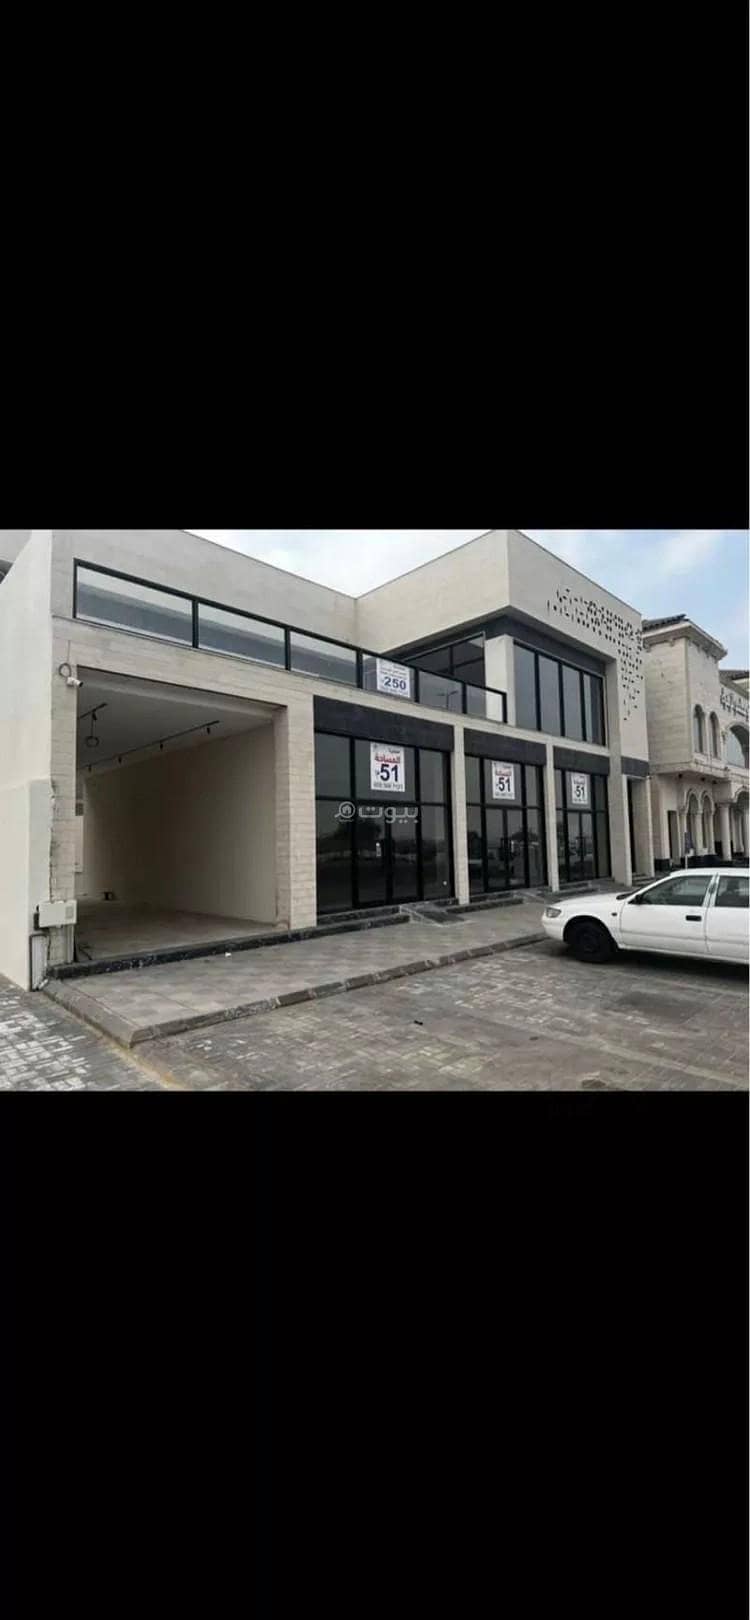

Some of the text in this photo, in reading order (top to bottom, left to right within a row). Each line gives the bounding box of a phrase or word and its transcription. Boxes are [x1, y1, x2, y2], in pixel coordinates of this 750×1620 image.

[384, 676, 406, 690] 250
[380, 763, 399, 782] 51
[498, 776, 511, 792] 51
